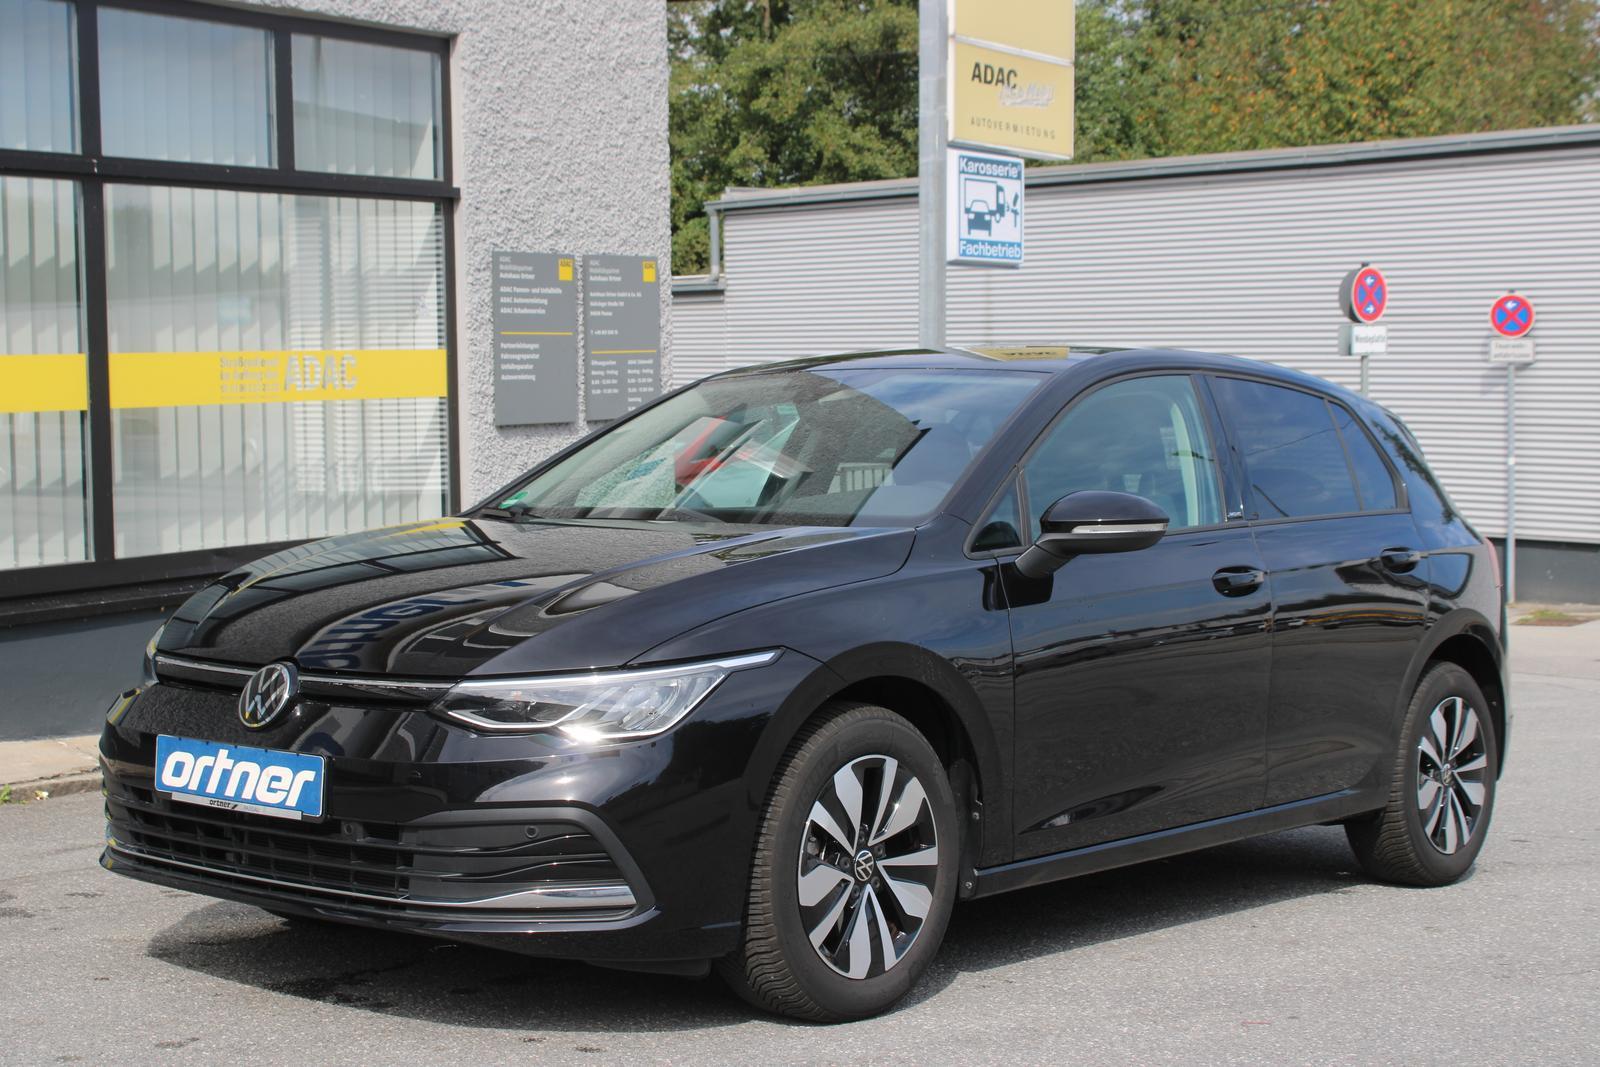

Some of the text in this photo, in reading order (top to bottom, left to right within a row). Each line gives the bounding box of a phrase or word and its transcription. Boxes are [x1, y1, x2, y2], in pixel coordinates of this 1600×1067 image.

[971, 62, 1017, 90] ADAC
[970, 117, 1056, 140] AUTOVERMIETUNG
[959, 157, 1018, 178] Karosserie
[960, 241, 1021, 259] Fachbetrieb
[284, 354, 358, 391] ADAC
[161, 748, 317, 807] ortner
[209, 799, 231, 808] ortner
